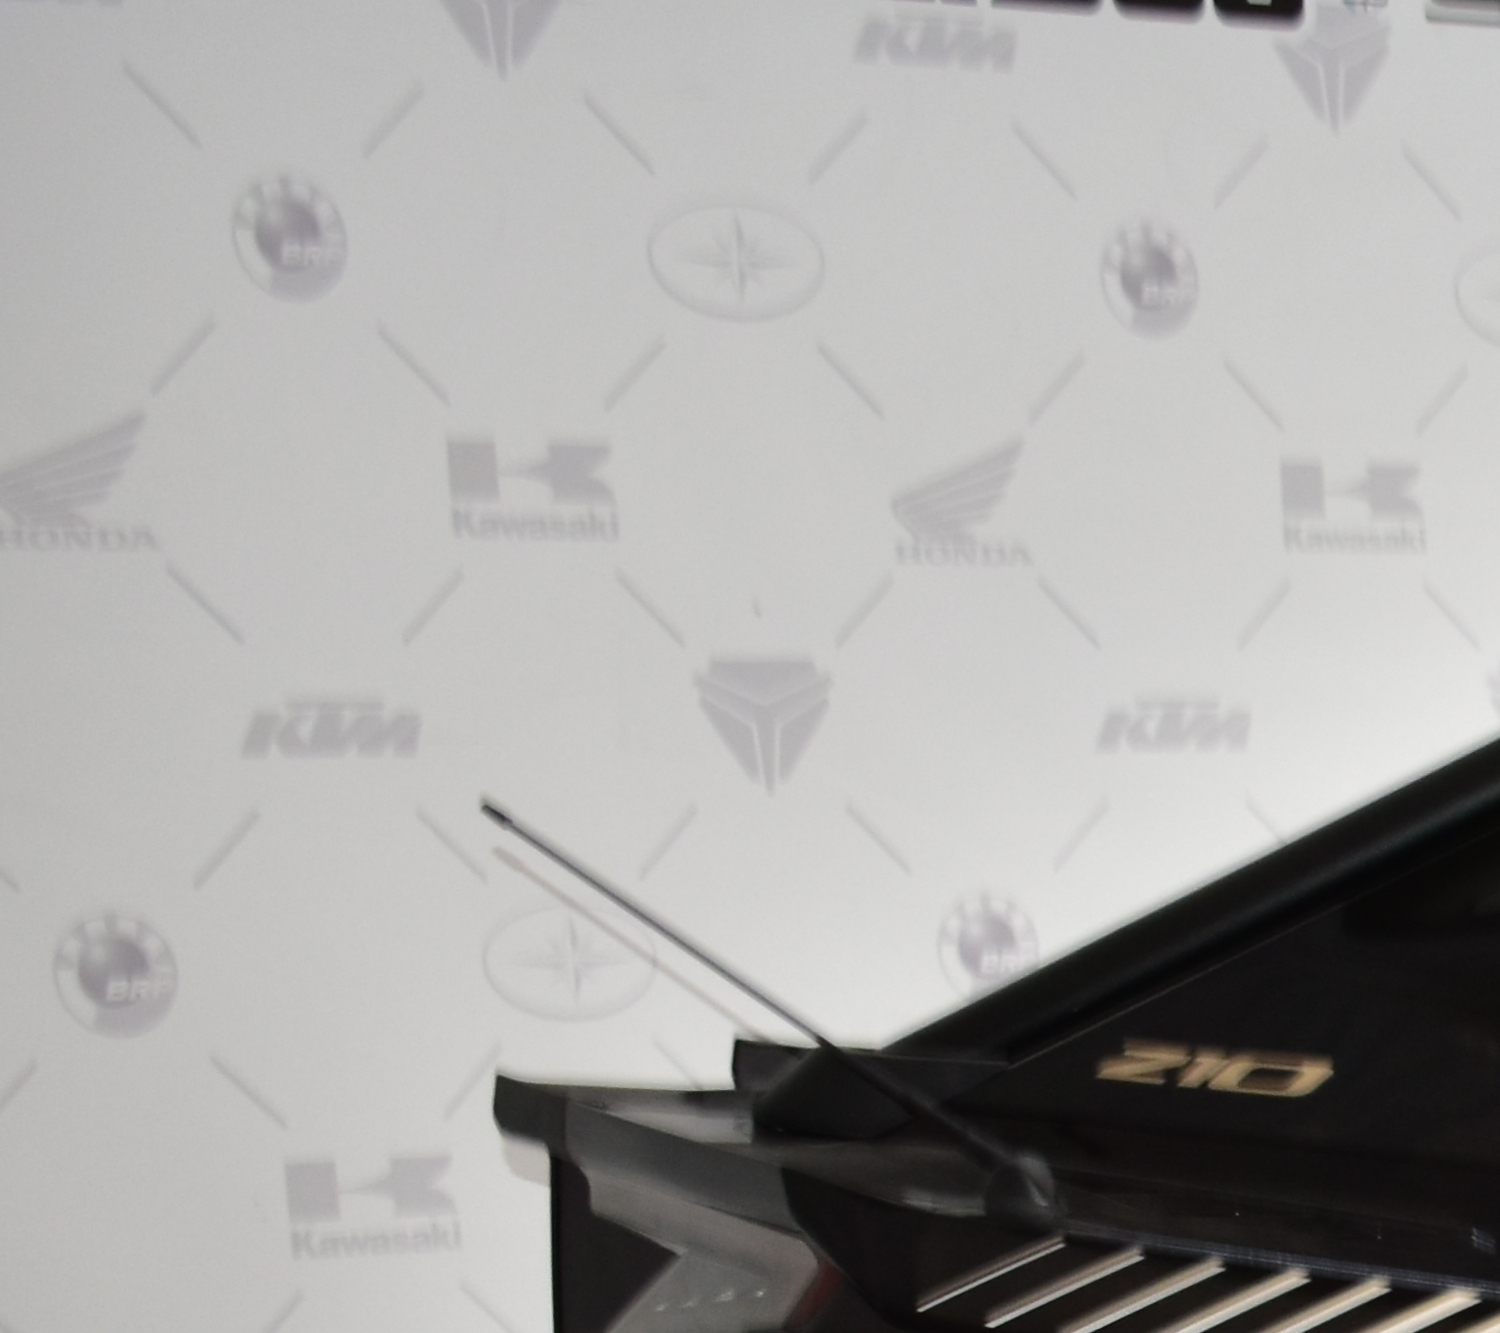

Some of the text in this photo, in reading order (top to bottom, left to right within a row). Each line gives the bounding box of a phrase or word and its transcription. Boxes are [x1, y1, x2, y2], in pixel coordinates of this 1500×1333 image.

[452, 510, 619, 541] Kawasaki
[240, 697, 421, 758] KTM
[1097, 696, 1252, 751] KTM
[1096, 1039, 1334, 1098] Z10
[290, 1221, 463, 1259] Kawasaki
